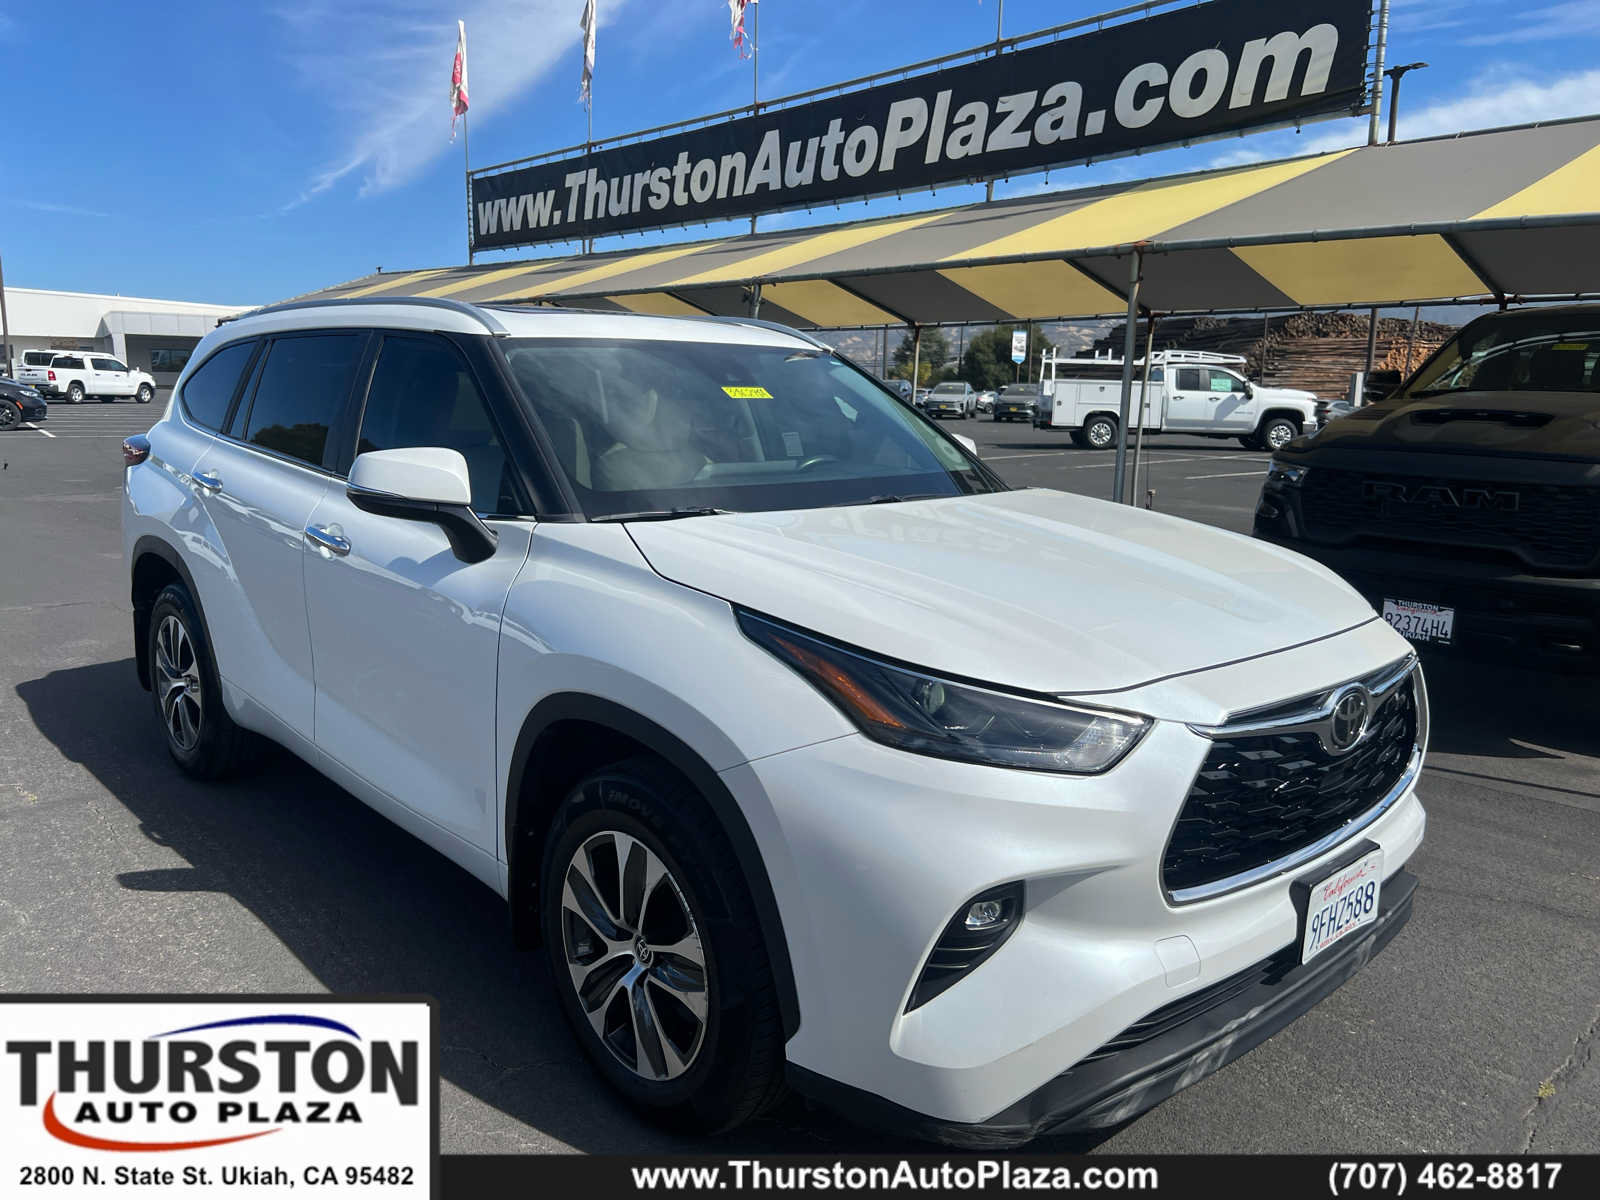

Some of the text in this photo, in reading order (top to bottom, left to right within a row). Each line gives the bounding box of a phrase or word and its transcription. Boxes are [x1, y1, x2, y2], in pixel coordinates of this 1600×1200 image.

[477, 23, 1338, 235] www.ThurstonAutoPlaza.com
[1363, 480, 1520, 514] RAM
[1385, 612, 1449, 638] 82374H4
[1309, 881, 1375, 952] 9FHZ588
